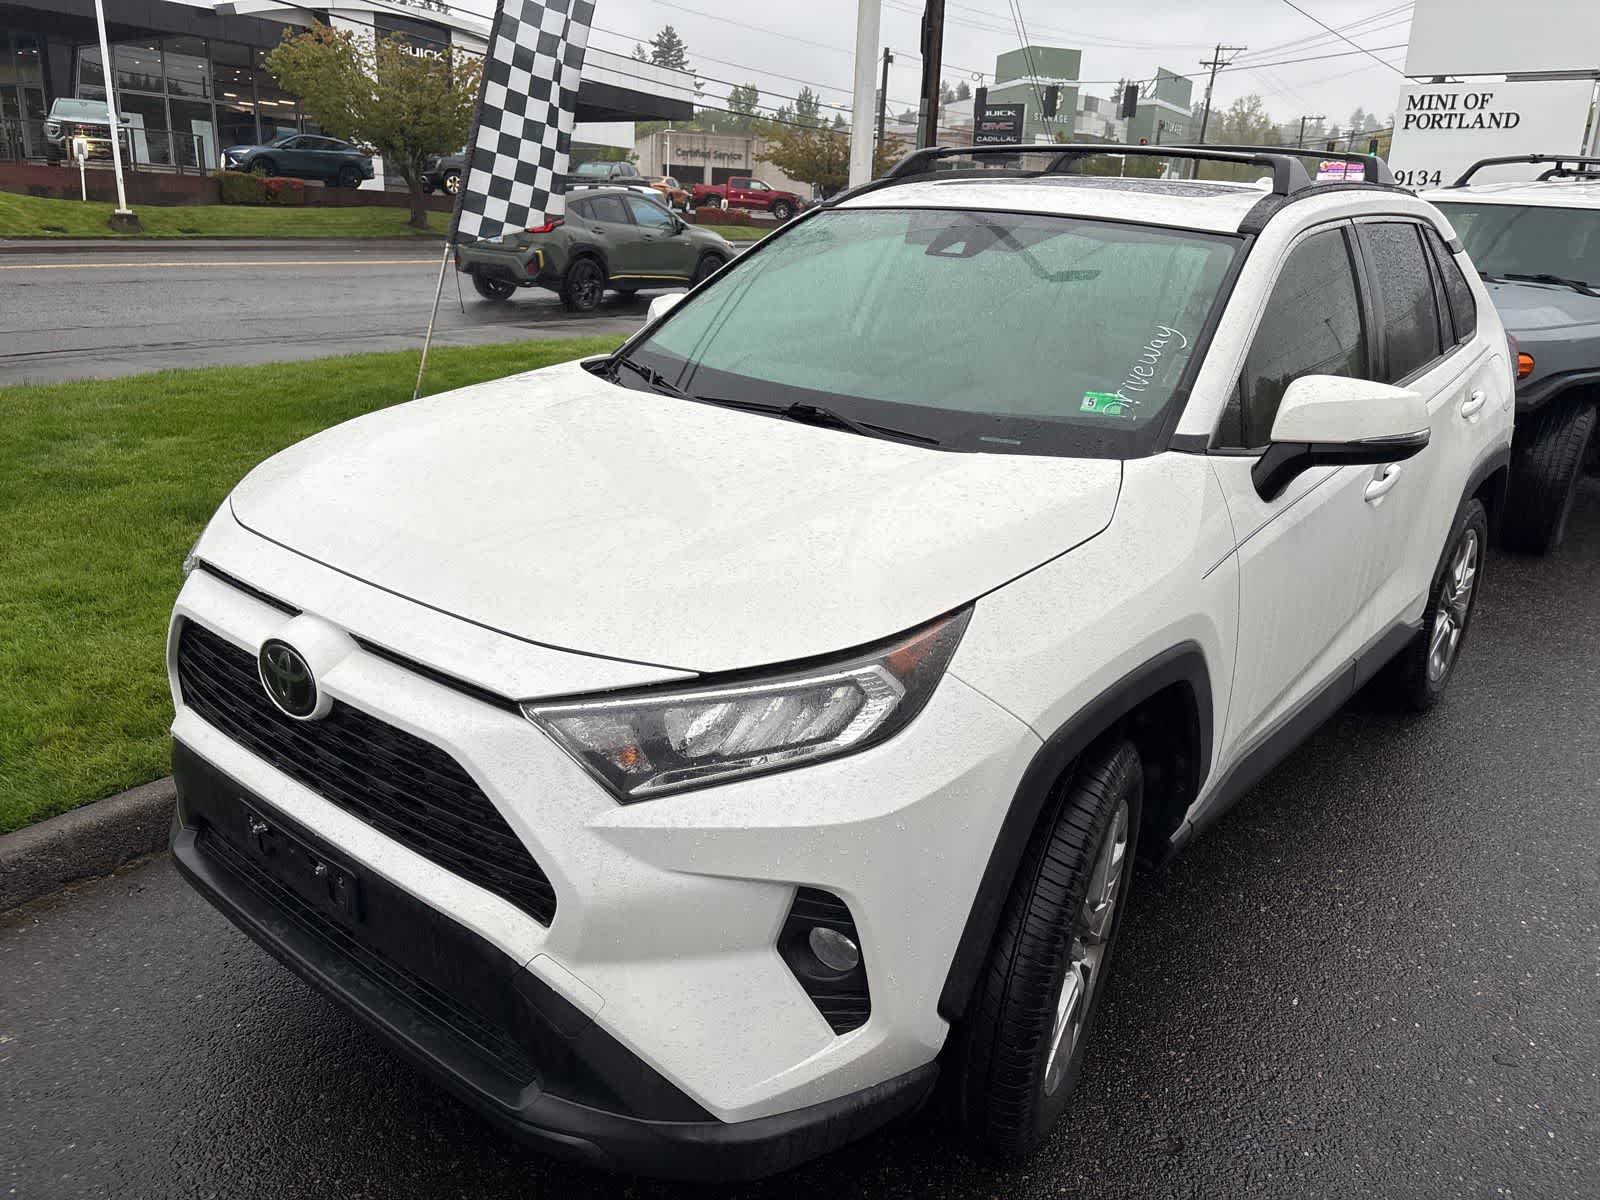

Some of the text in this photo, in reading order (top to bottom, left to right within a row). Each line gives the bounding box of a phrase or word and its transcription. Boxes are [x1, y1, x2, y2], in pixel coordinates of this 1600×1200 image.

[1406, 93, 1494, 111] MINI OF
[1403, 112, 1521, 130] PORTLAND
[713, 150, 743, 161] Service
[1394, 170, 1442, 187] 9134
[1087, 397, 1095, 407] 5
